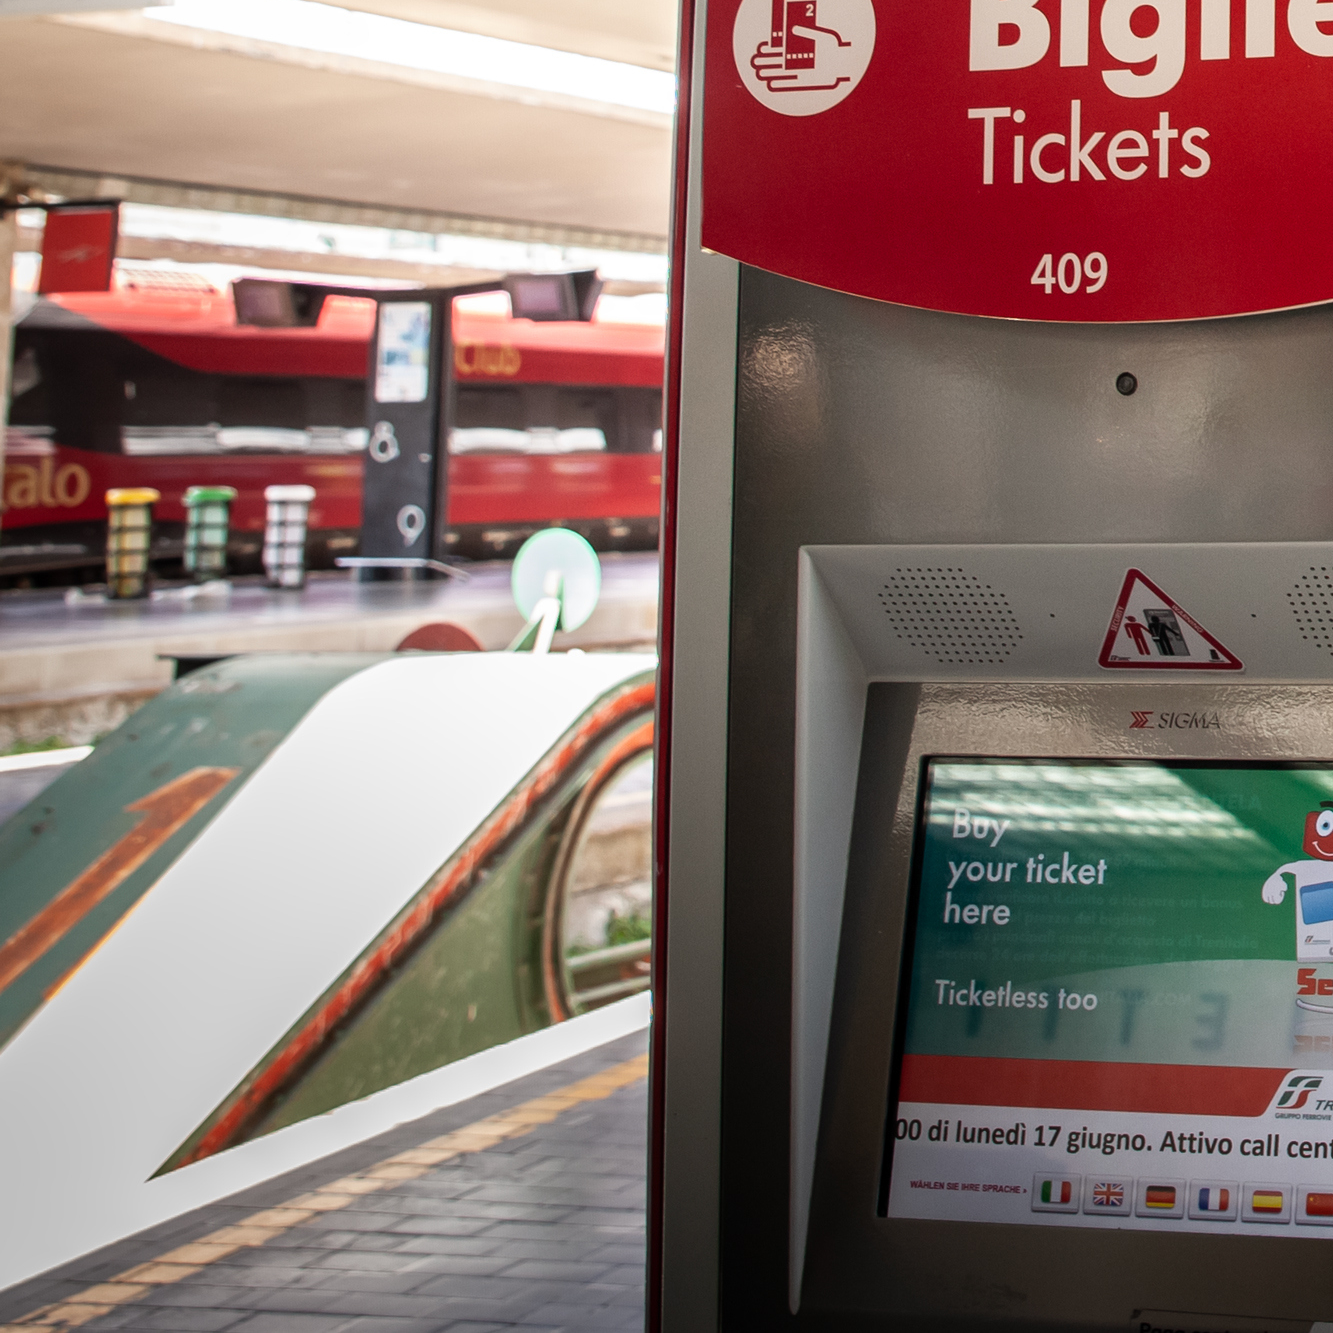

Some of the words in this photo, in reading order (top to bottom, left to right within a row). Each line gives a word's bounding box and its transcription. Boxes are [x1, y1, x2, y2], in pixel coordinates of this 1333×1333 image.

[967, 98, 1213, 185] Tickets
[1030, 249, 1109, 295] 409
[1110, 605, 1125, 633] SECURITY
[1157, 711, 1222, 730] SIGMA
[952, 807, 1010, 846] Buy
[948, 859, 1018, 890] your
[1025, 850, 1108, 885] ticket
[943, 890, 1011, 926] here
[934, 978, 1049, 1010] Ticketless
[1057, 987, 1098, 1011] too
[1302, 1113, 1332, 1121] FERROVIE
[895, 1118, 922, 1141] 00
[928, 1120, 949, 1142] di
[956, 1120, 1026, 1146] lunedì
[1033, 1125, 1062, 1147] 17
[1066, 1126, 1152, 1155] giugno.
[1159, 1130, 1233, 1155] Attivo
[1240, 1133, 1280, 1157] call
[946, 1182, 960, 1191] SIE
[961, 1182, 981, 1192] IHRE
[982, 1183, 1021, 1194] SPRACHE
